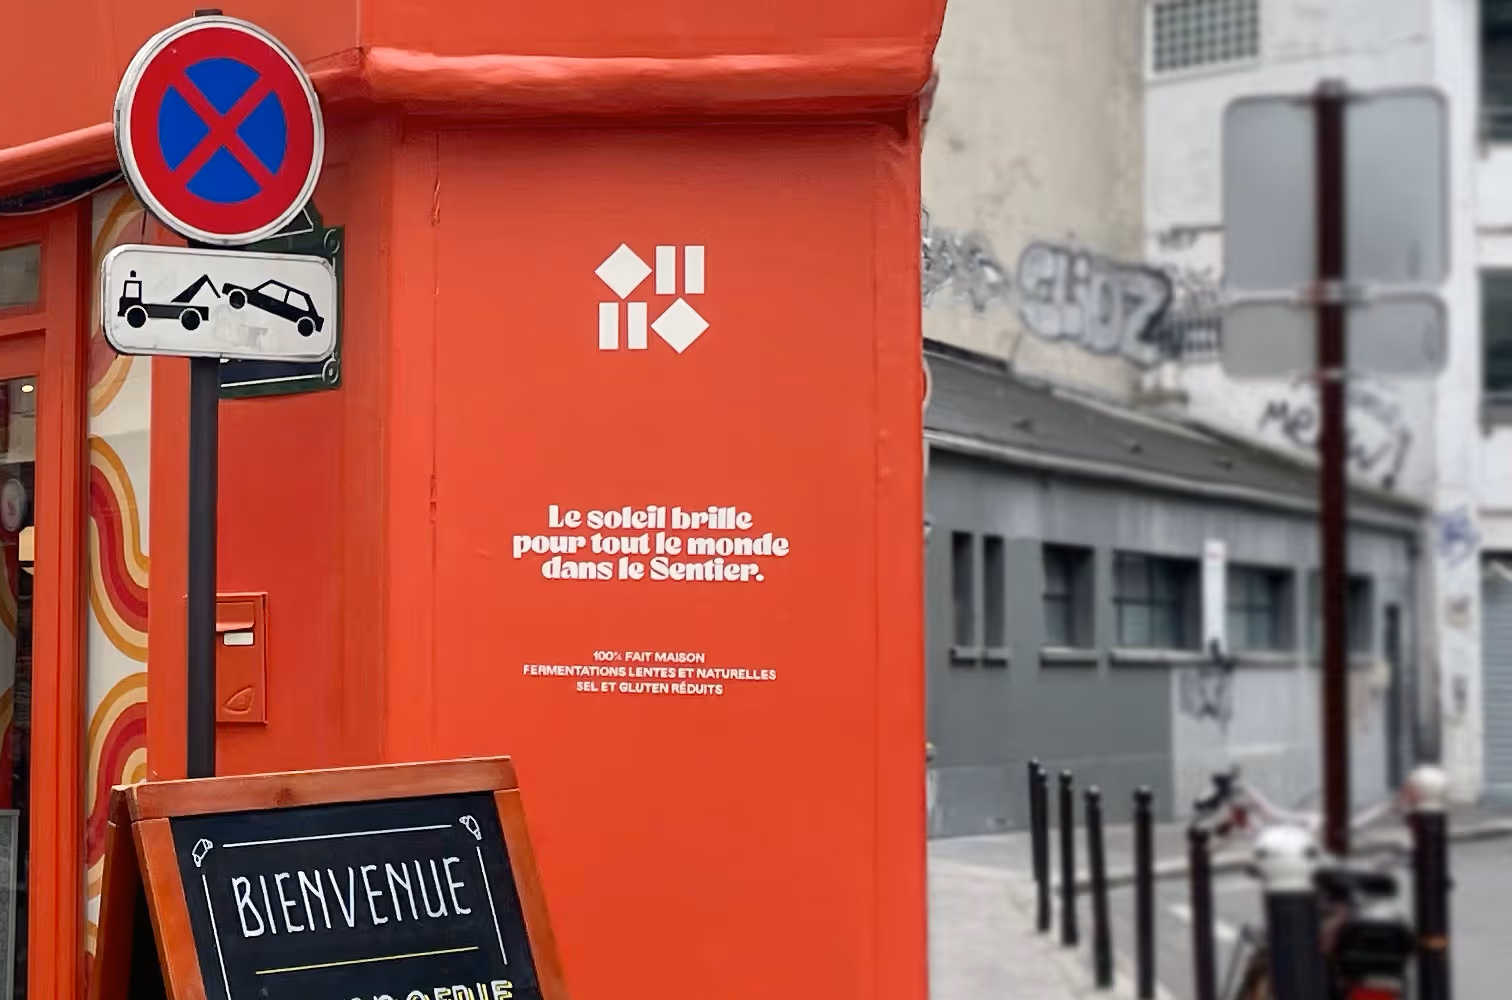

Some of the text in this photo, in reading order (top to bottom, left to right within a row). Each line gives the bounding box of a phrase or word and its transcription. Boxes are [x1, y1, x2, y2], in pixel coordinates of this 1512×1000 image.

[548, 504, 753, 530] Le soleil brille
[513, 532, 789, 559] pour tout le monde
[542, 556, 764, 582] dans le Sentier.
[593, 651, 705, 663] 100% FAIT MAISON
[523, 664, 776, 680] FERMENTATIONS LENTES ET NATURELLES
[576, 680, 723, 695] SEL ET GLUTEN RÉDUITS
[231, 856, 472, 938] BIENVENUE
